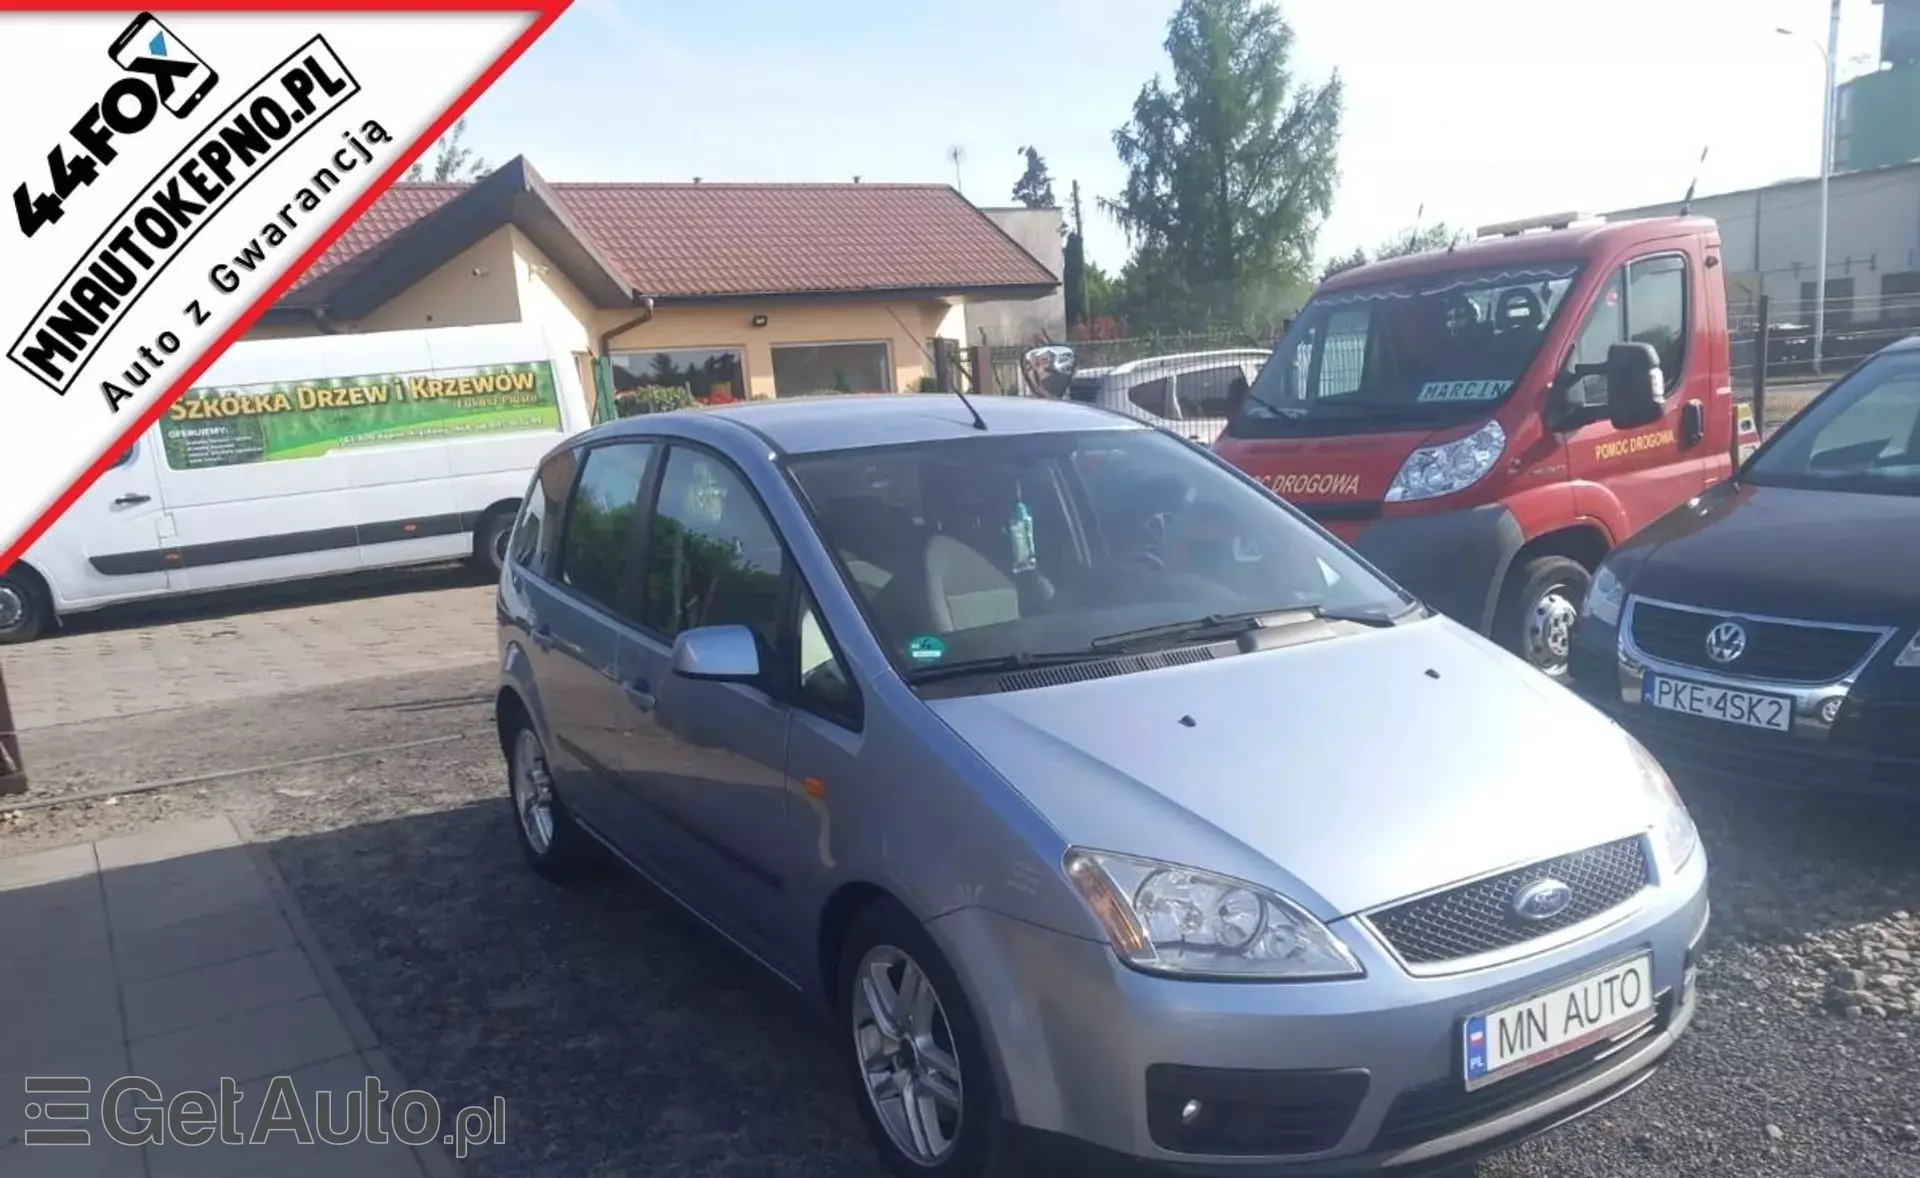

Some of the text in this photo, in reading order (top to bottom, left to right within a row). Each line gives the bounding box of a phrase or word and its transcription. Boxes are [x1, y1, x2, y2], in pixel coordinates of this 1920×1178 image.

[1423, 382, 1514, 398] MARCIN
[1595, 430, 1675, 460] POMOC DROGOWA
[1271, 473, 1360, 495] DROGOWA
[1658, 680, 1783, 728] PKE 4SK2
[1499, 968, 1641, 1059] MN AUTO
